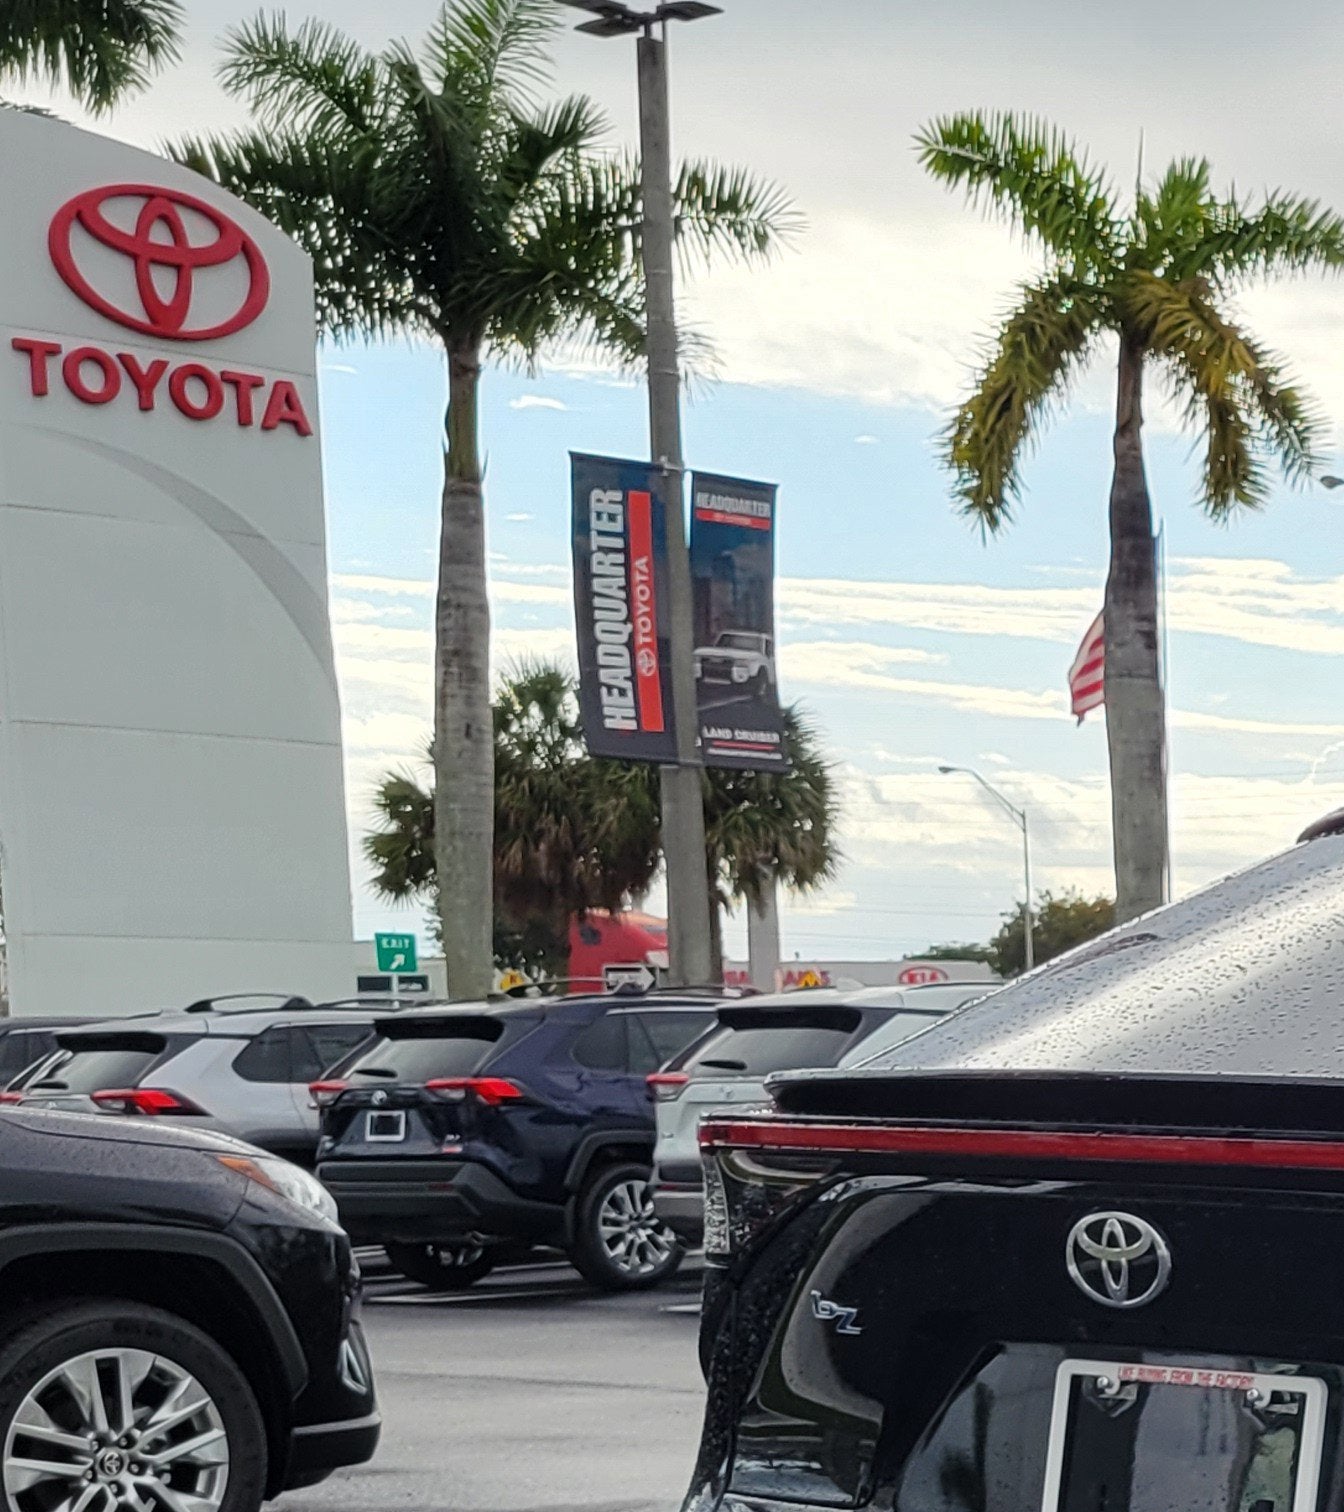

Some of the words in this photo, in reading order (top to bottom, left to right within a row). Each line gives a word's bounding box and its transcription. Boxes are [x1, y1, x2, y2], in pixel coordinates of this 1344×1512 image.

[11, 337, 313, 437] TOYOTA
[589, 487, 639, 731] HEADQUARTER
[631, 555, 655, 645] TOYOTA
[381, 937, 410, 949] EXIT
